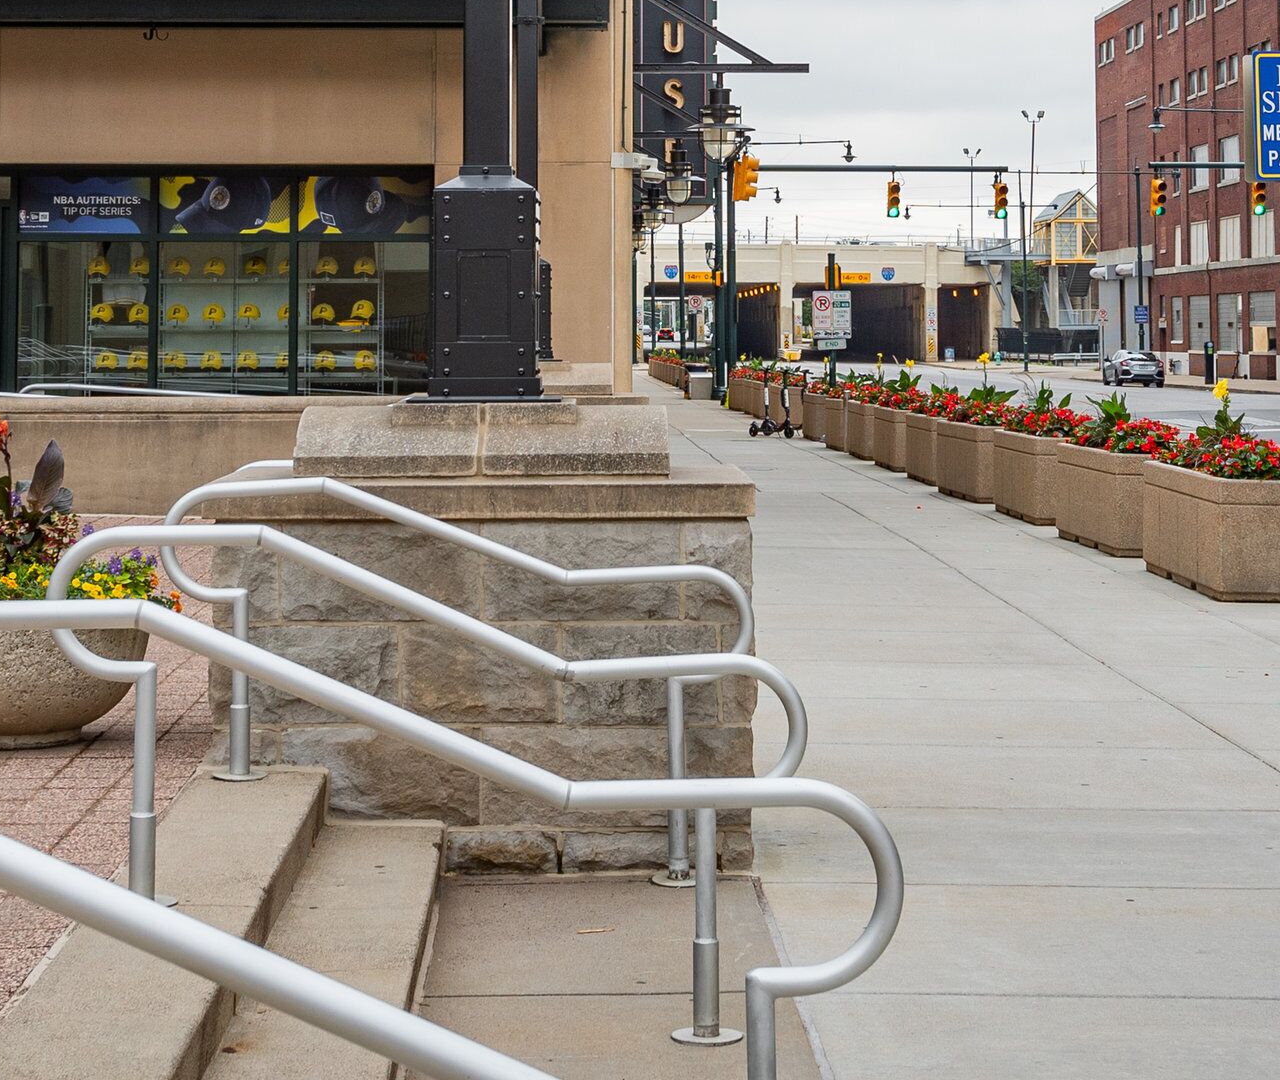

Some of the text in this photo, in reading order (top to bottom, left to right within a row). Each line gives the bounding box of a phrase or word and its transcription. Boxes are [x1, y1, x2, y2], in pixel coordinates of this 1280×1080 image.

[53, 196, 141, 205] NBA AUTHENTICS:
[63, 207, 132, 216] TIP OFF SERIES
